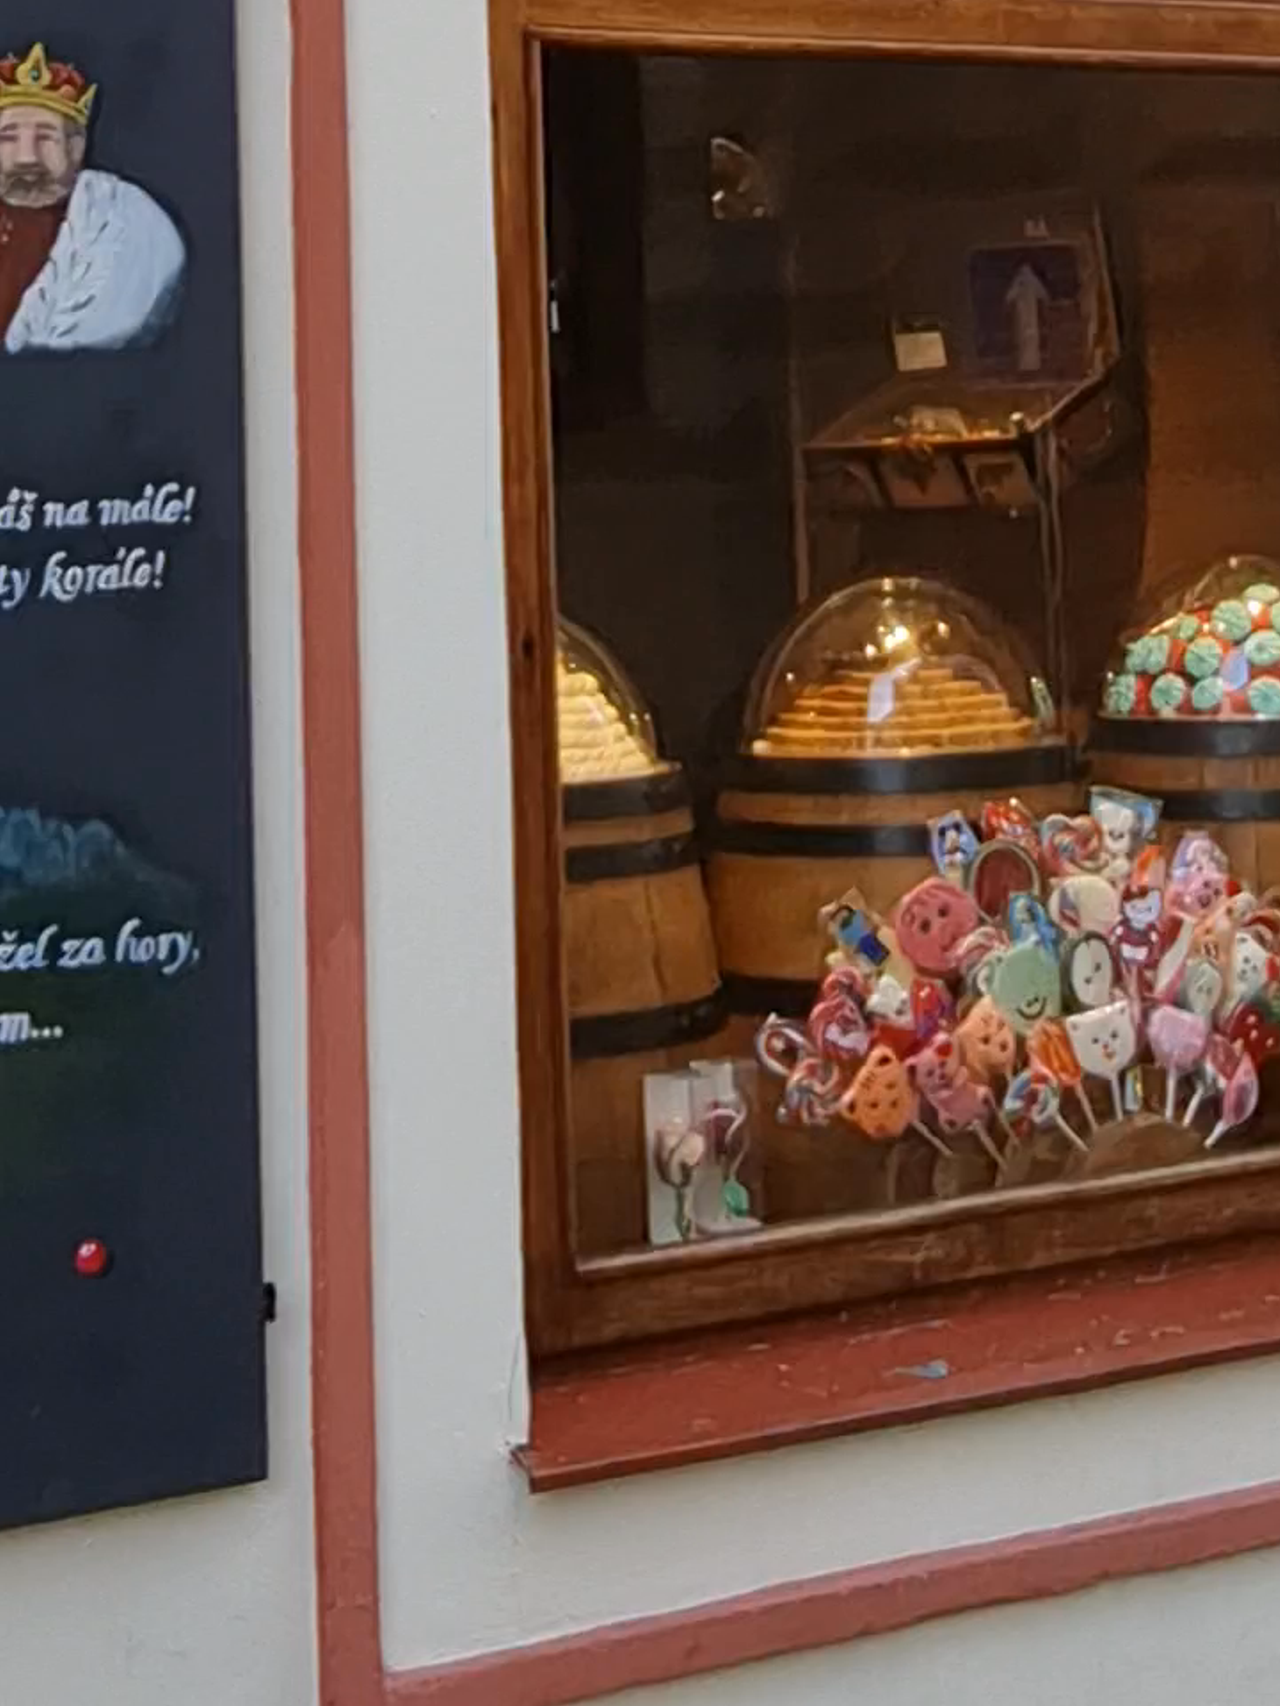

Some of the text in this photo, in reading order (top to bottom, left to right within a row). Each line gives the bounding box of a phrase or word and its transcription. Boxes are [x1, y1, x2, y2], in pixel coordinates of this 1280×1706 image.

[42, 498, 90, 529] na
[97, 481, 197, 527] mále!
[38, 545, 166, 603] korále!
[58, 937, 104, 968] za
